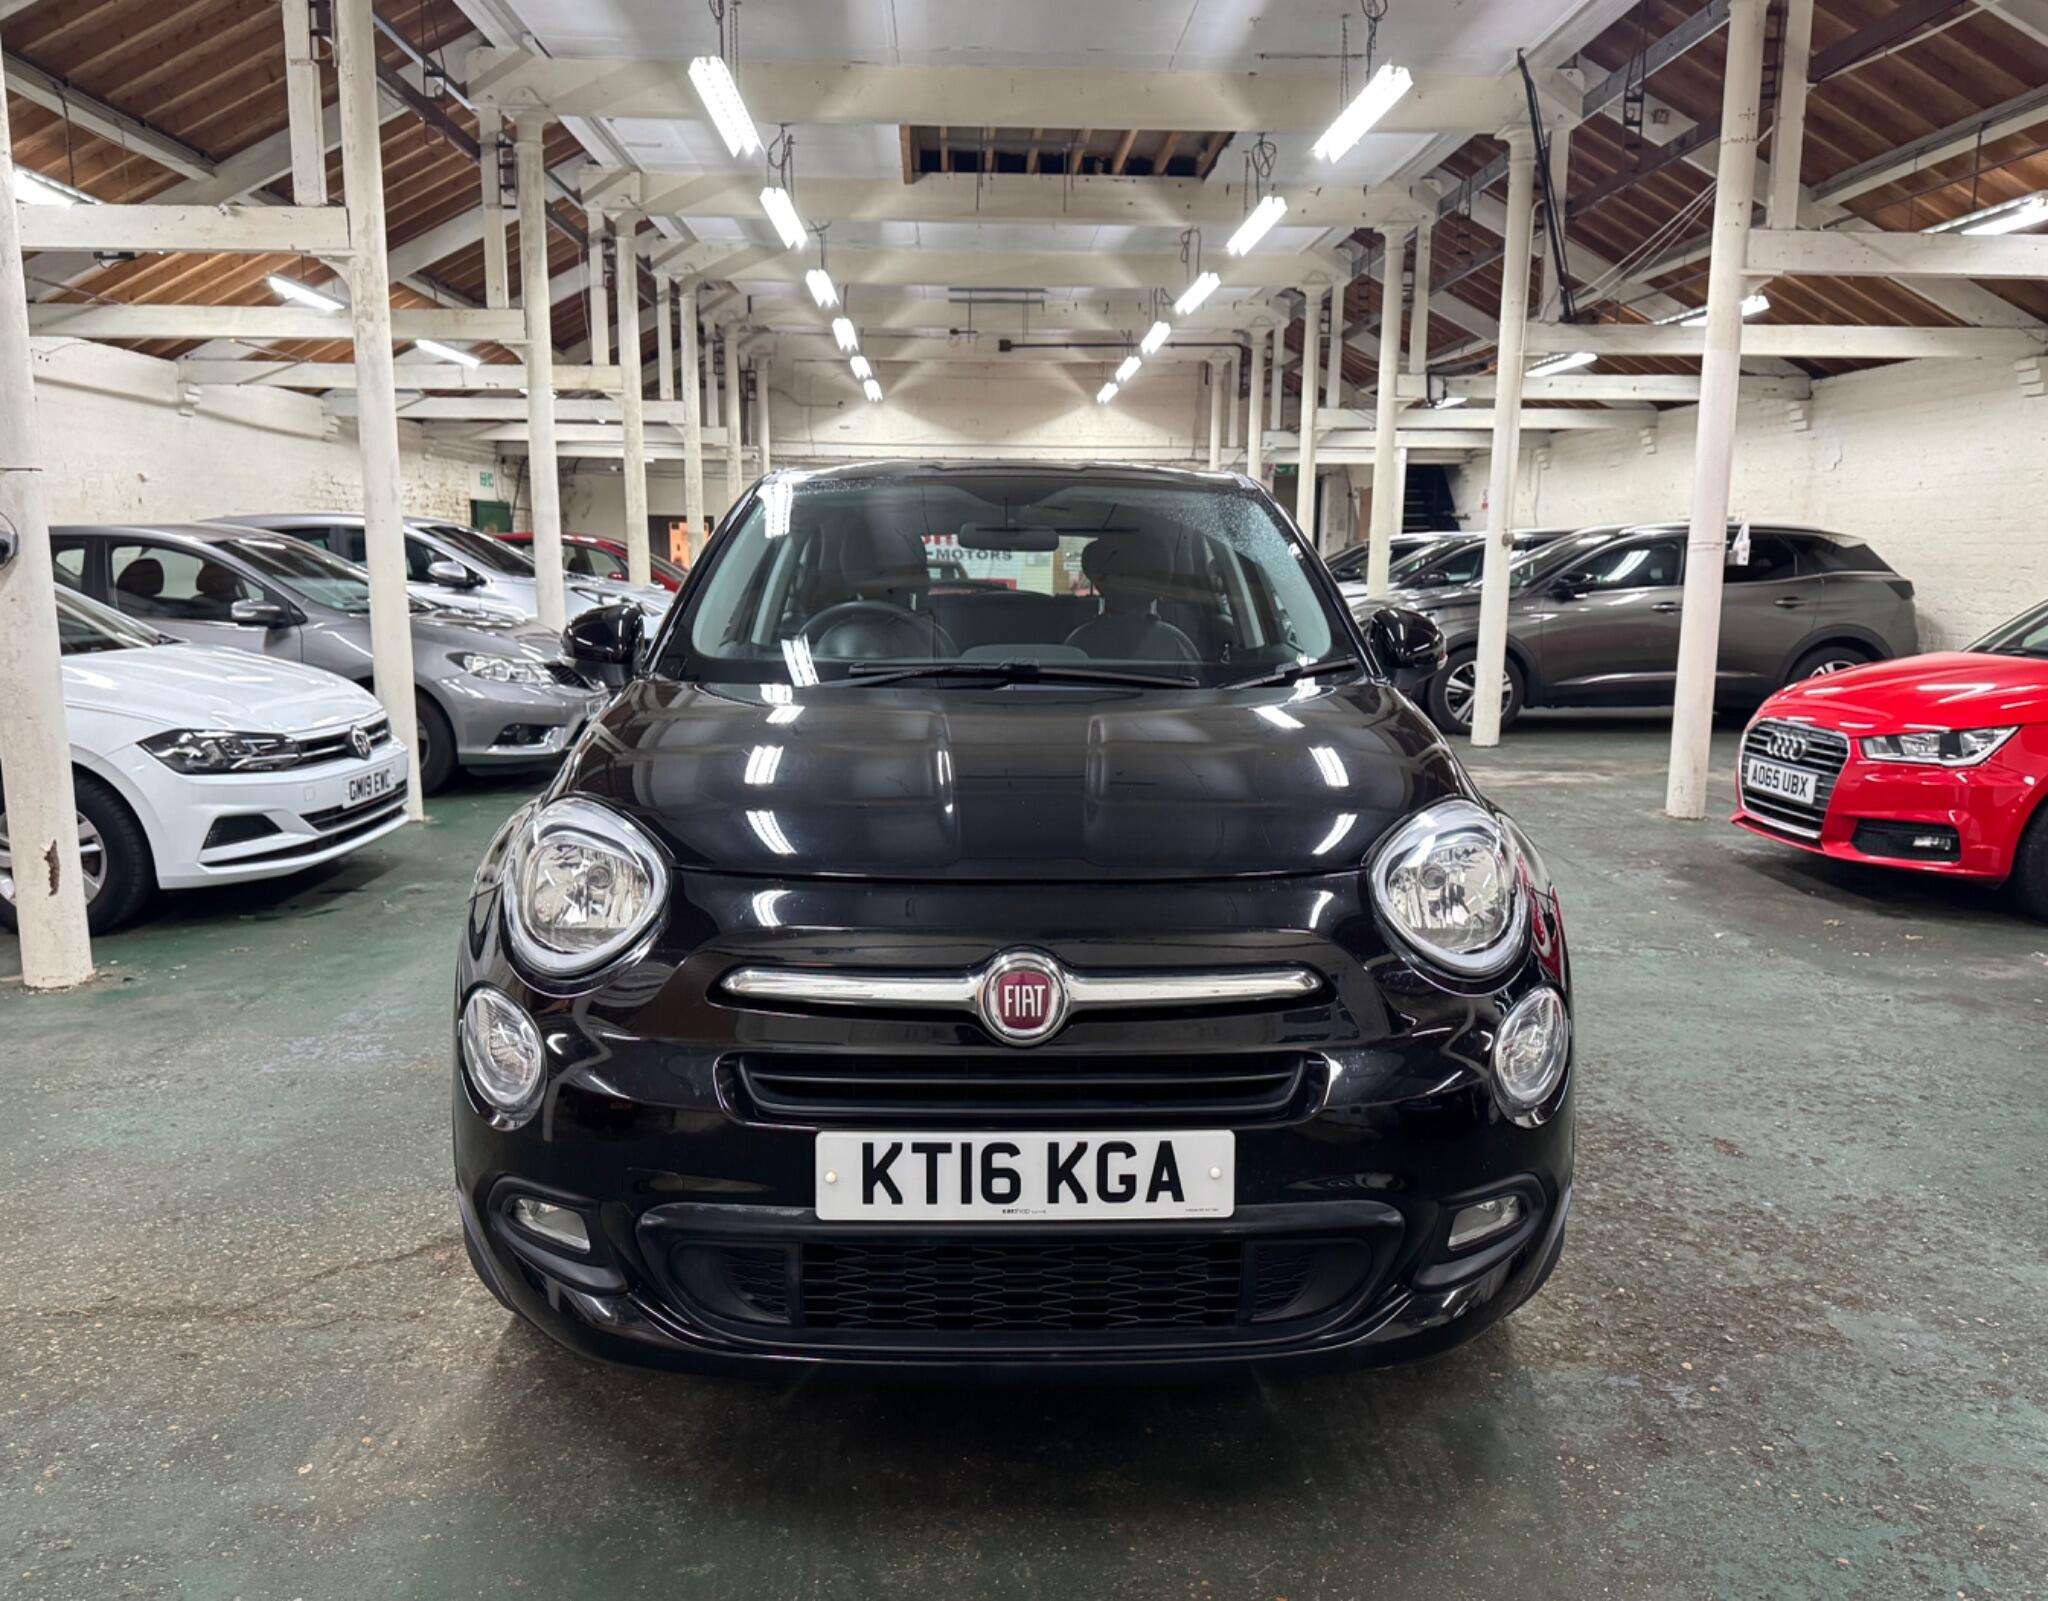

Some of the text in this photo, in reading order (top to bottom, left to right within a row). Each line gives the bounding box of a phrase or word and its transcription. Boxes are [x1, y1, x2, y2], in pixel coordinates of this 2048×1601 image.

[936, 549, 1012, 560] MOTORS
[1782, 771, 1808, 798] UBX
[1004, 985, 1046, 1018] FIAT
[862, 1140, 1186, 1205] KT16 KGA
